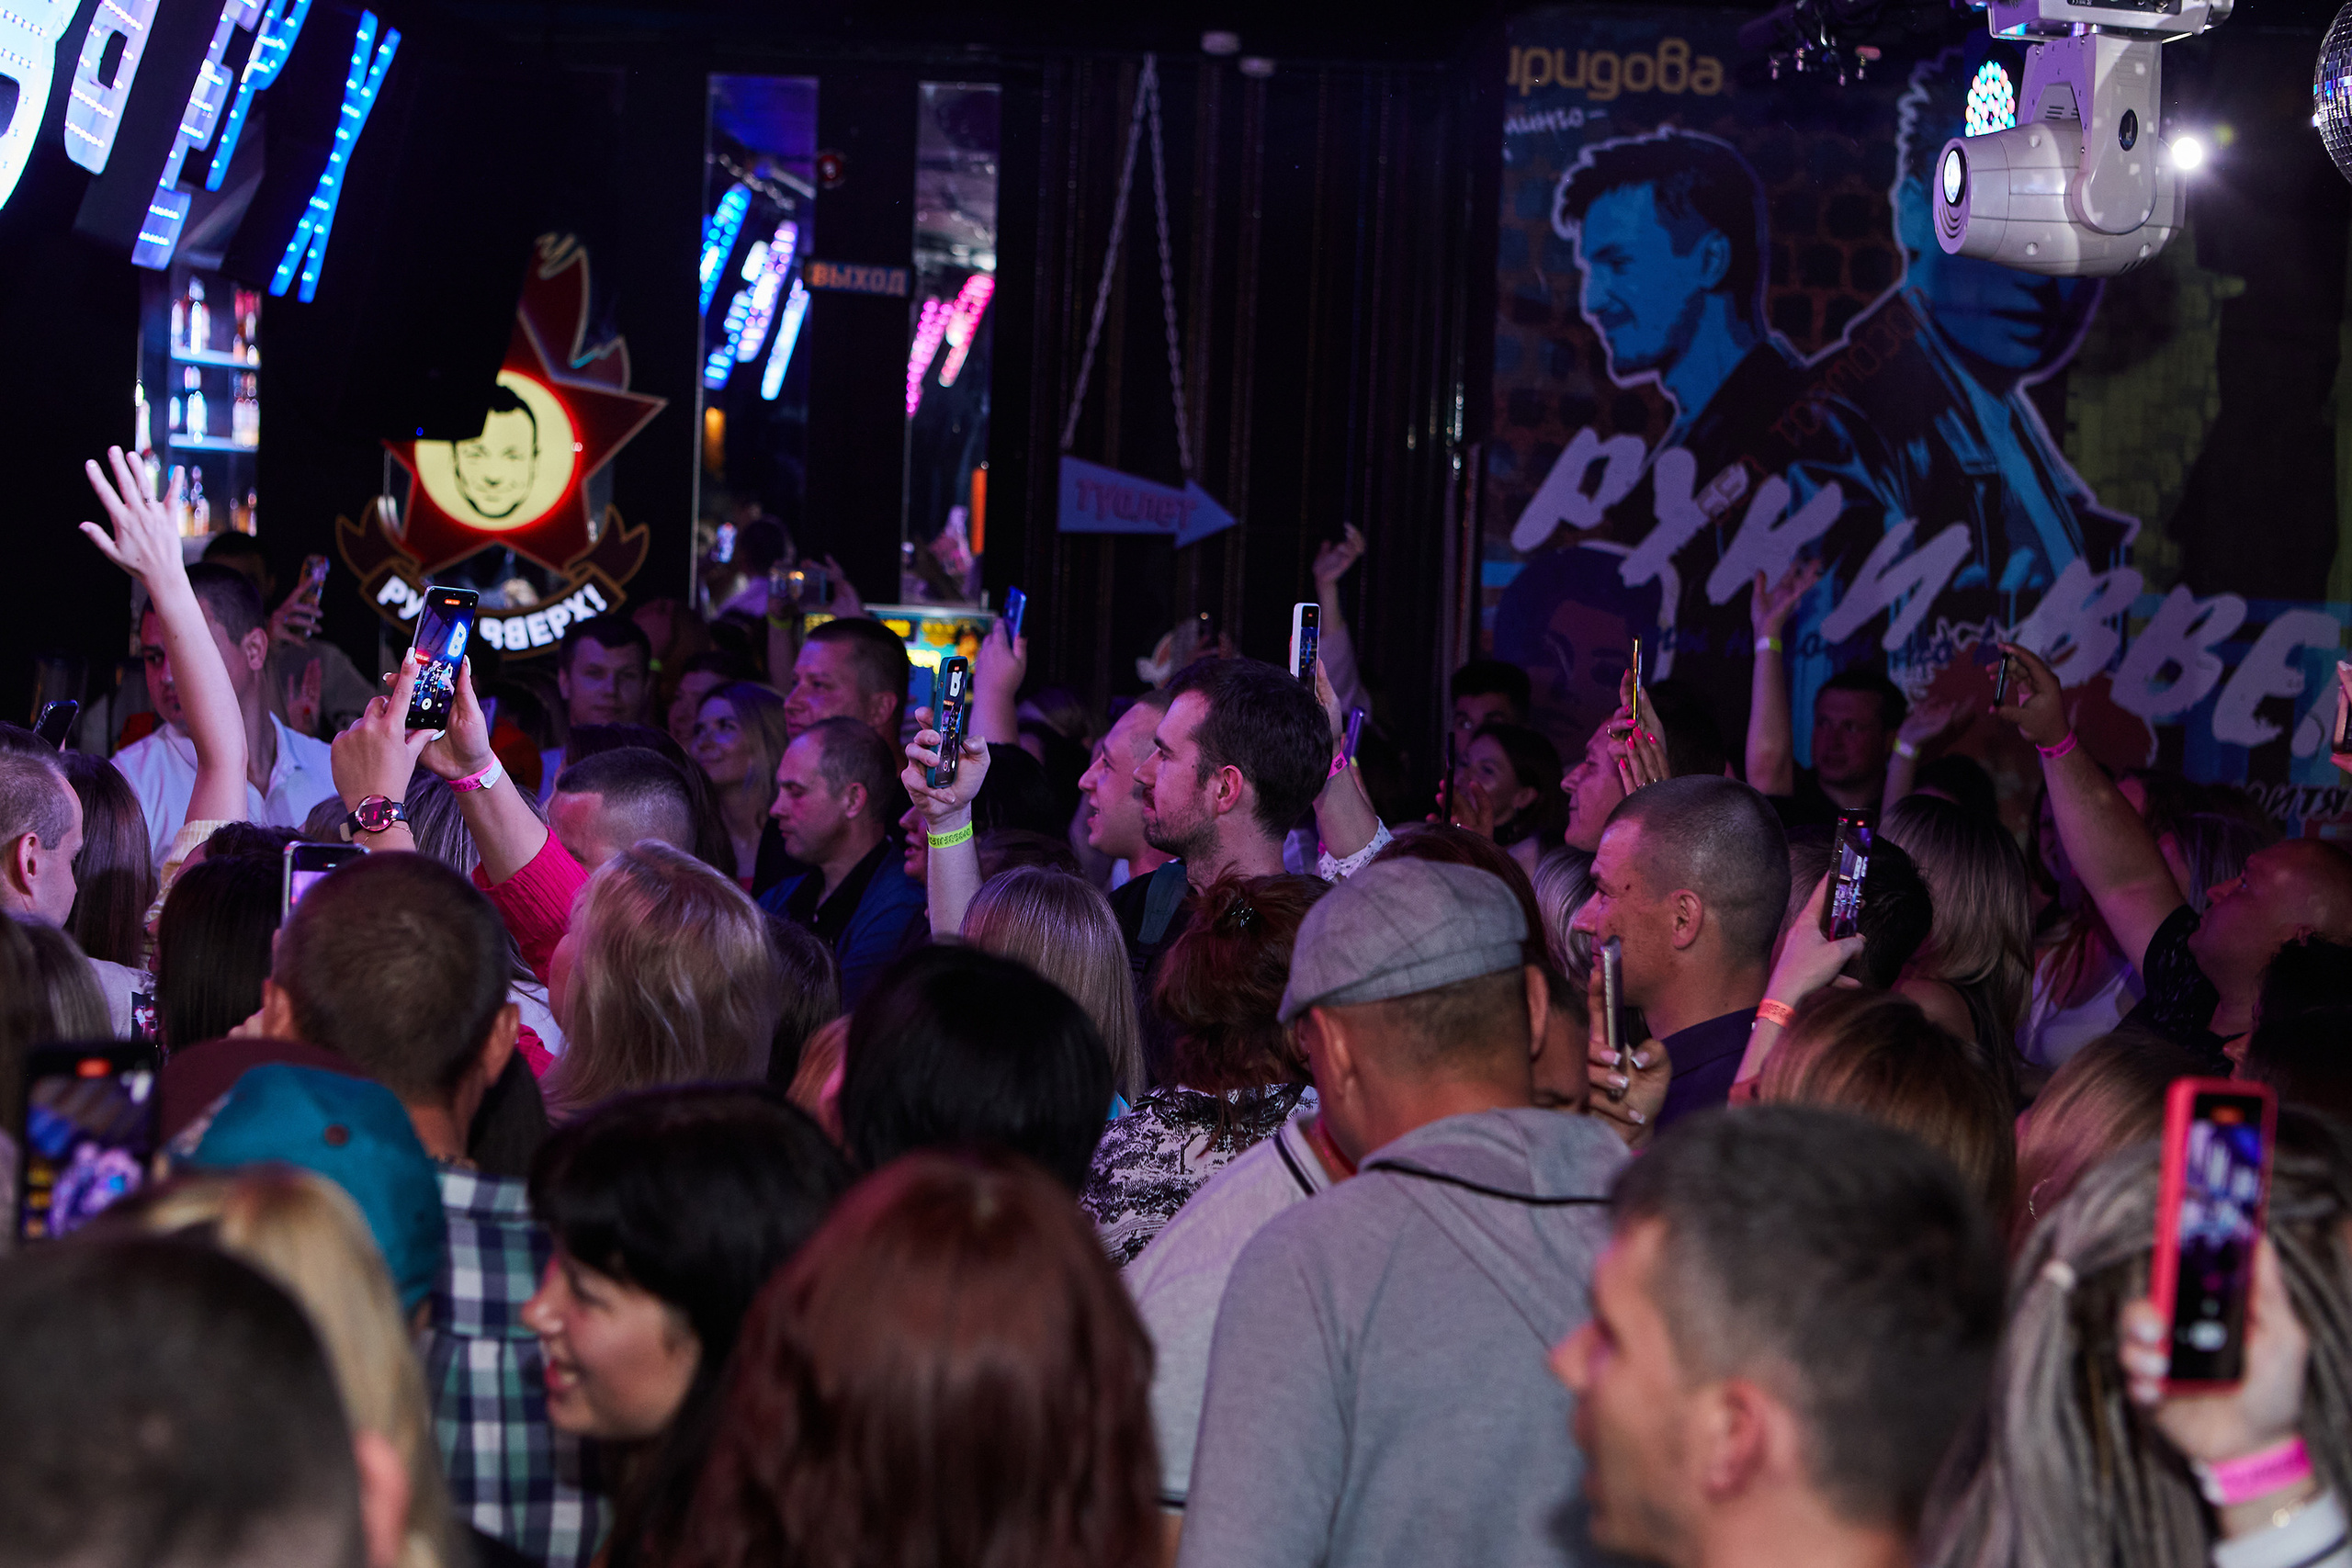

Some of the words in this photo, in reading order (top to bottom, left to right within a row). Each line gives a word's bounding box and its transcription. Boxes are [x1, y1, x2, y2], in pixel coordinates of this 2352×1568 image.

[812, 262, 906, 297] ВЫХОД
[1511, 426, 1971, 652] РУКИ
[377, 575, 424, 621] РУ
